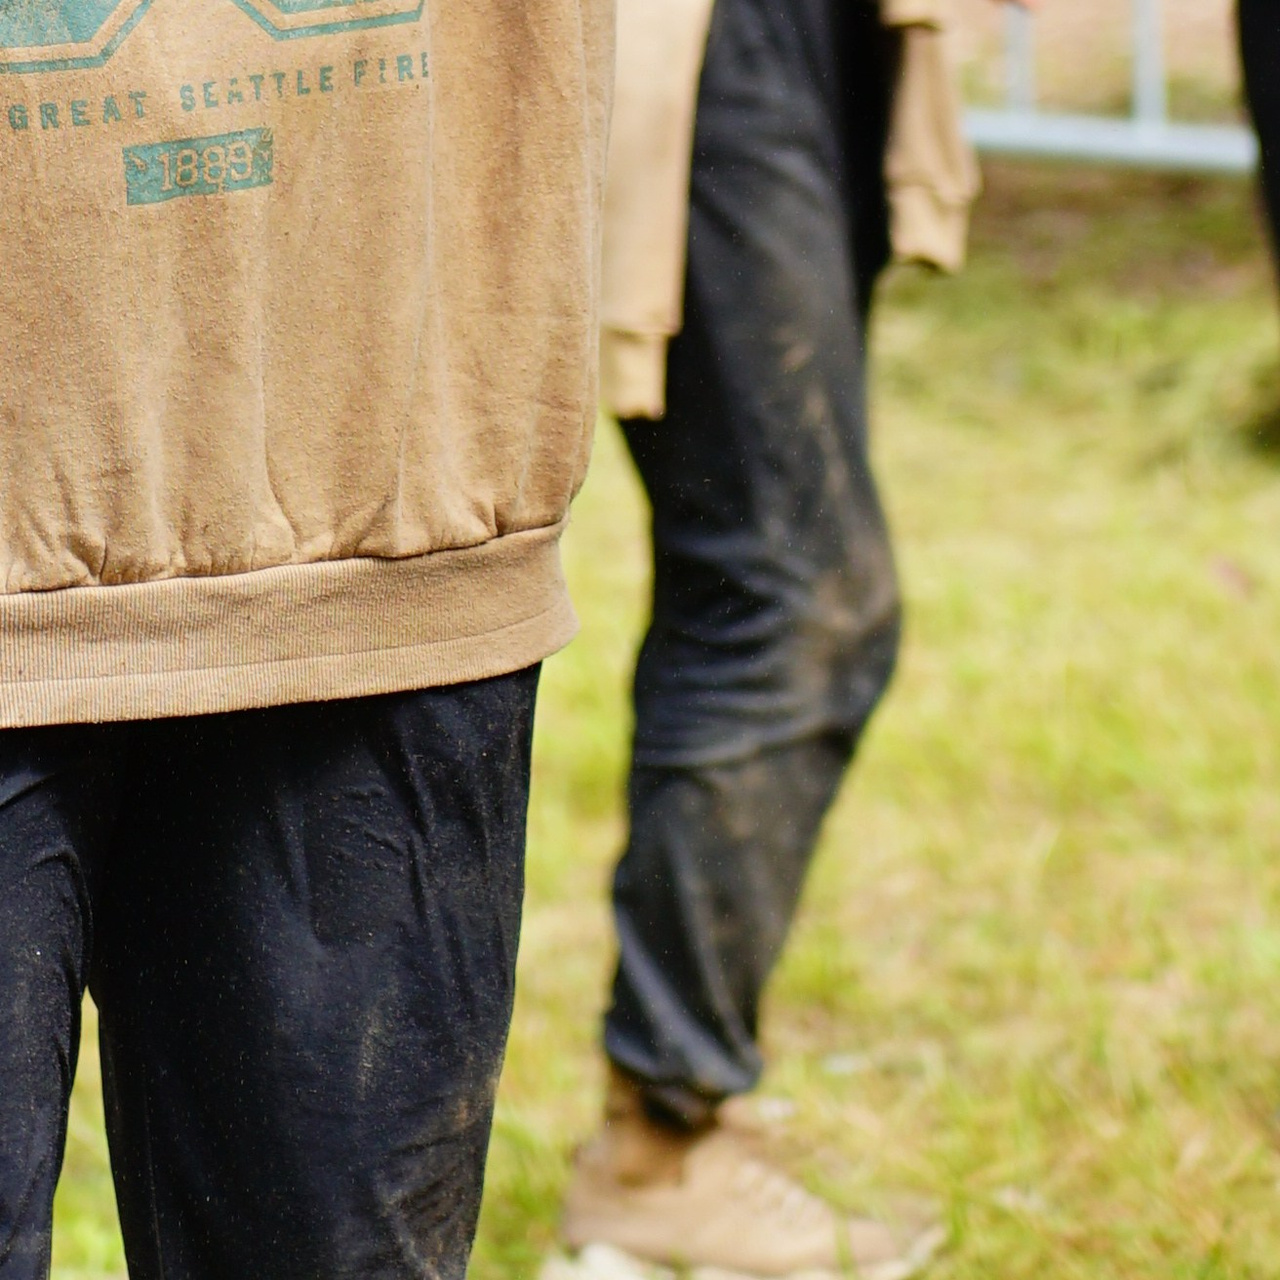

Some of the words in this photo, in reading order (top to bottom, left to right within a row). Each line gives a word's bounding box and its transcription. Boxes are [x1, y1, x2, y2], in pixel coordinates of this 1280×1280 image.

[7, 91, 148, 130] GREAT
[179, 65, 335, 112] SEATTLE
[157, 140, 253, 191] 1889
